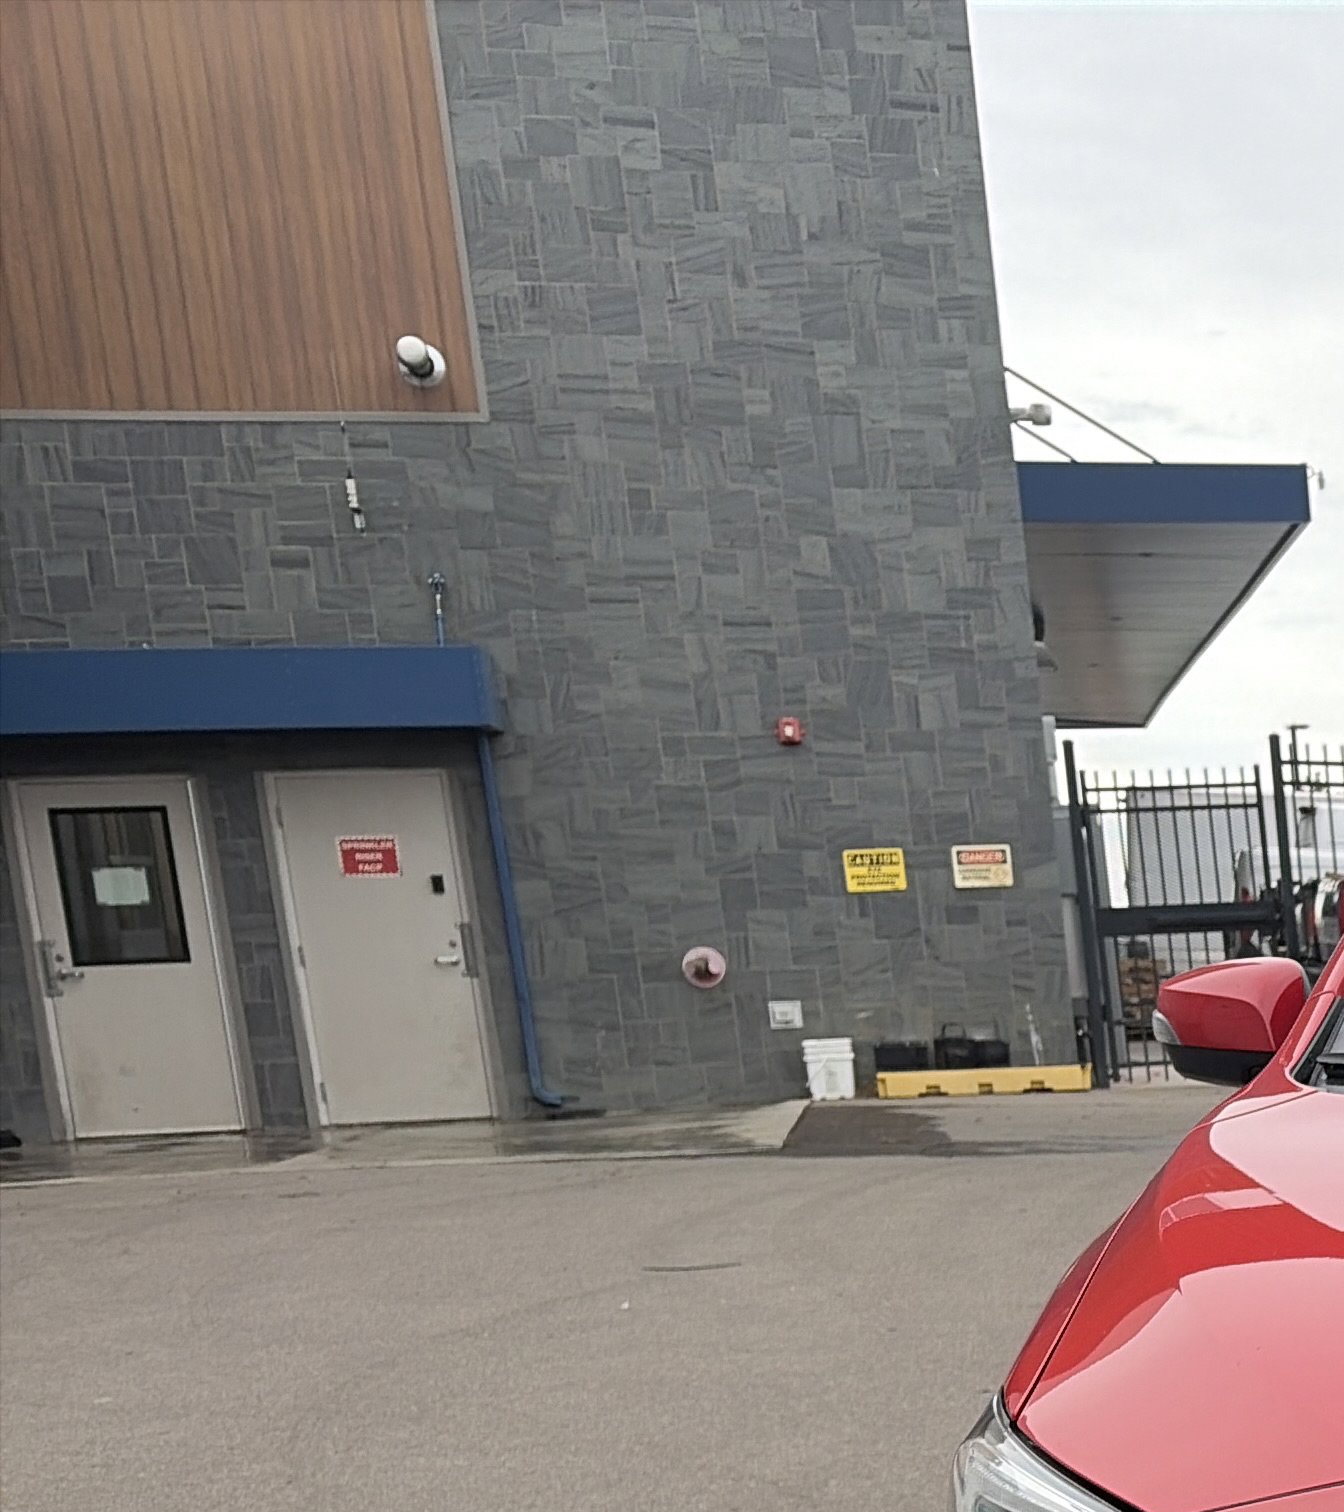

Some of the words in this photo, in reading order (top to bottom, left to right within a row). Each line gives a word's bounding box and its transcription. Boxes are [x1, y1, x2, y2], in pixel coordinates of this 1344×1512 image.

[341, 841, 393, 850] SPRINKLER
[355, 852, 383, 861] RISER
[847, 853, 899, 866] CAUTION
[960, 852, 1003, 863] DANGER
